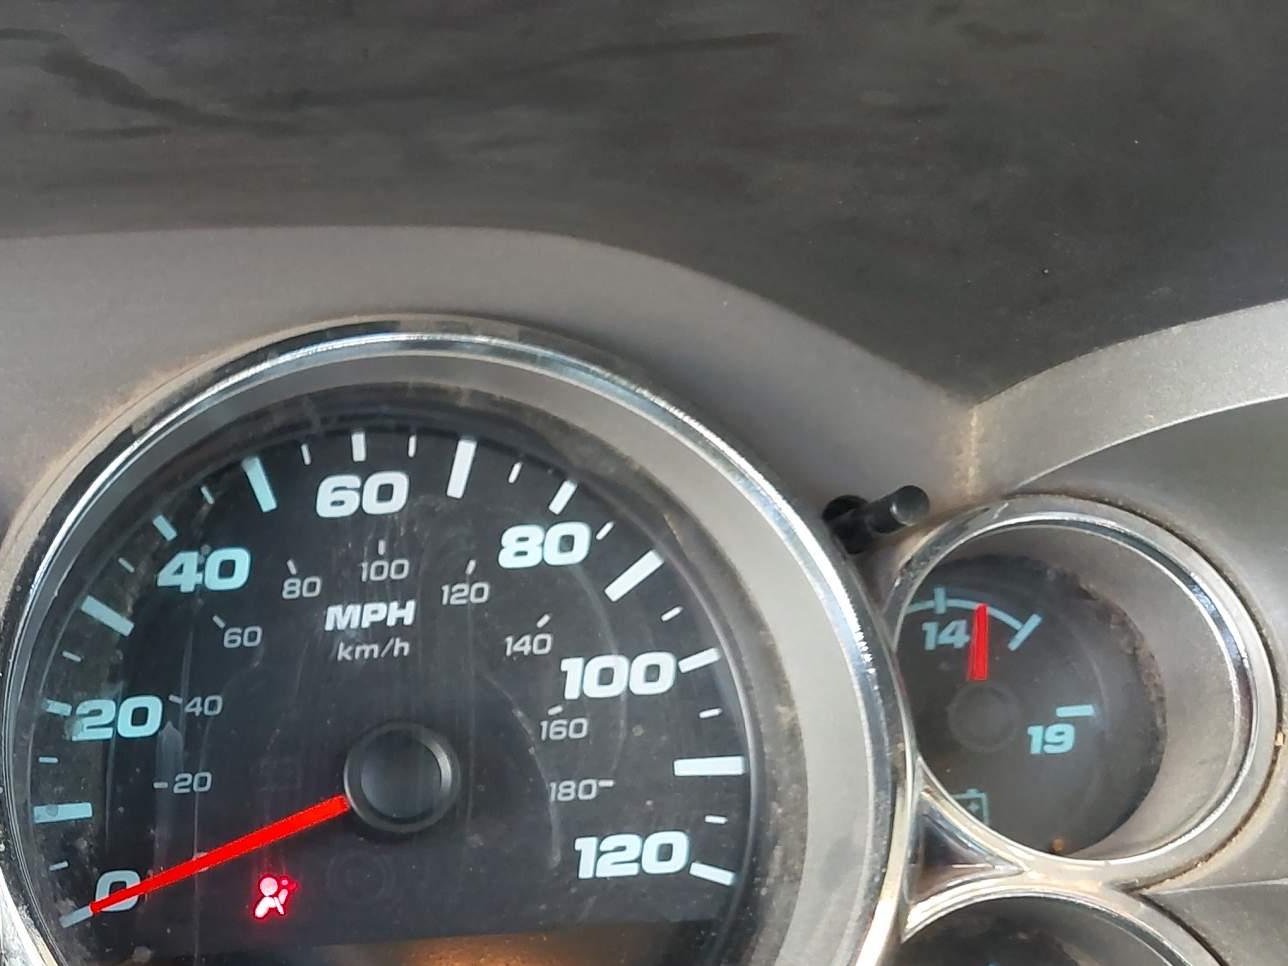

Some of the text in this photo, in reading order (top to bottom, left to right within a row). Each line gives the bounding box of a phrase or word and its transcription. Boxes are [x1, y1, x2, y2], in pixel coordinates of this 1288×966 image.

[315, 472, 409, 519] 60
[496, 521, 592, 569] 80
[155, 546, 252, 594] 40
[360, 558, 412, 583] 100
[281, 575, 323, 601] 80
[440, 580, 490, 606] 120
[323, 602, 416, 633] MPH
[222, 624, 264, 650] 60
[504, 631, 555, 657] 140
[922, 620, 970, 650] 14
[336, 638, 412, 662] km/h
[560, 651, 677, 700] 100
[70, 694, 165, 743] 20
[183, 693, 224, 718] 40
[538, 717, 590, 743] 160
[1027, 723, 1076, 756] 19
[172, 771, 214, 797] 20
[548, 778, 600, 803] 180
[573, 829, 691, 881] 120
[94, 869, 142, 913] 0
